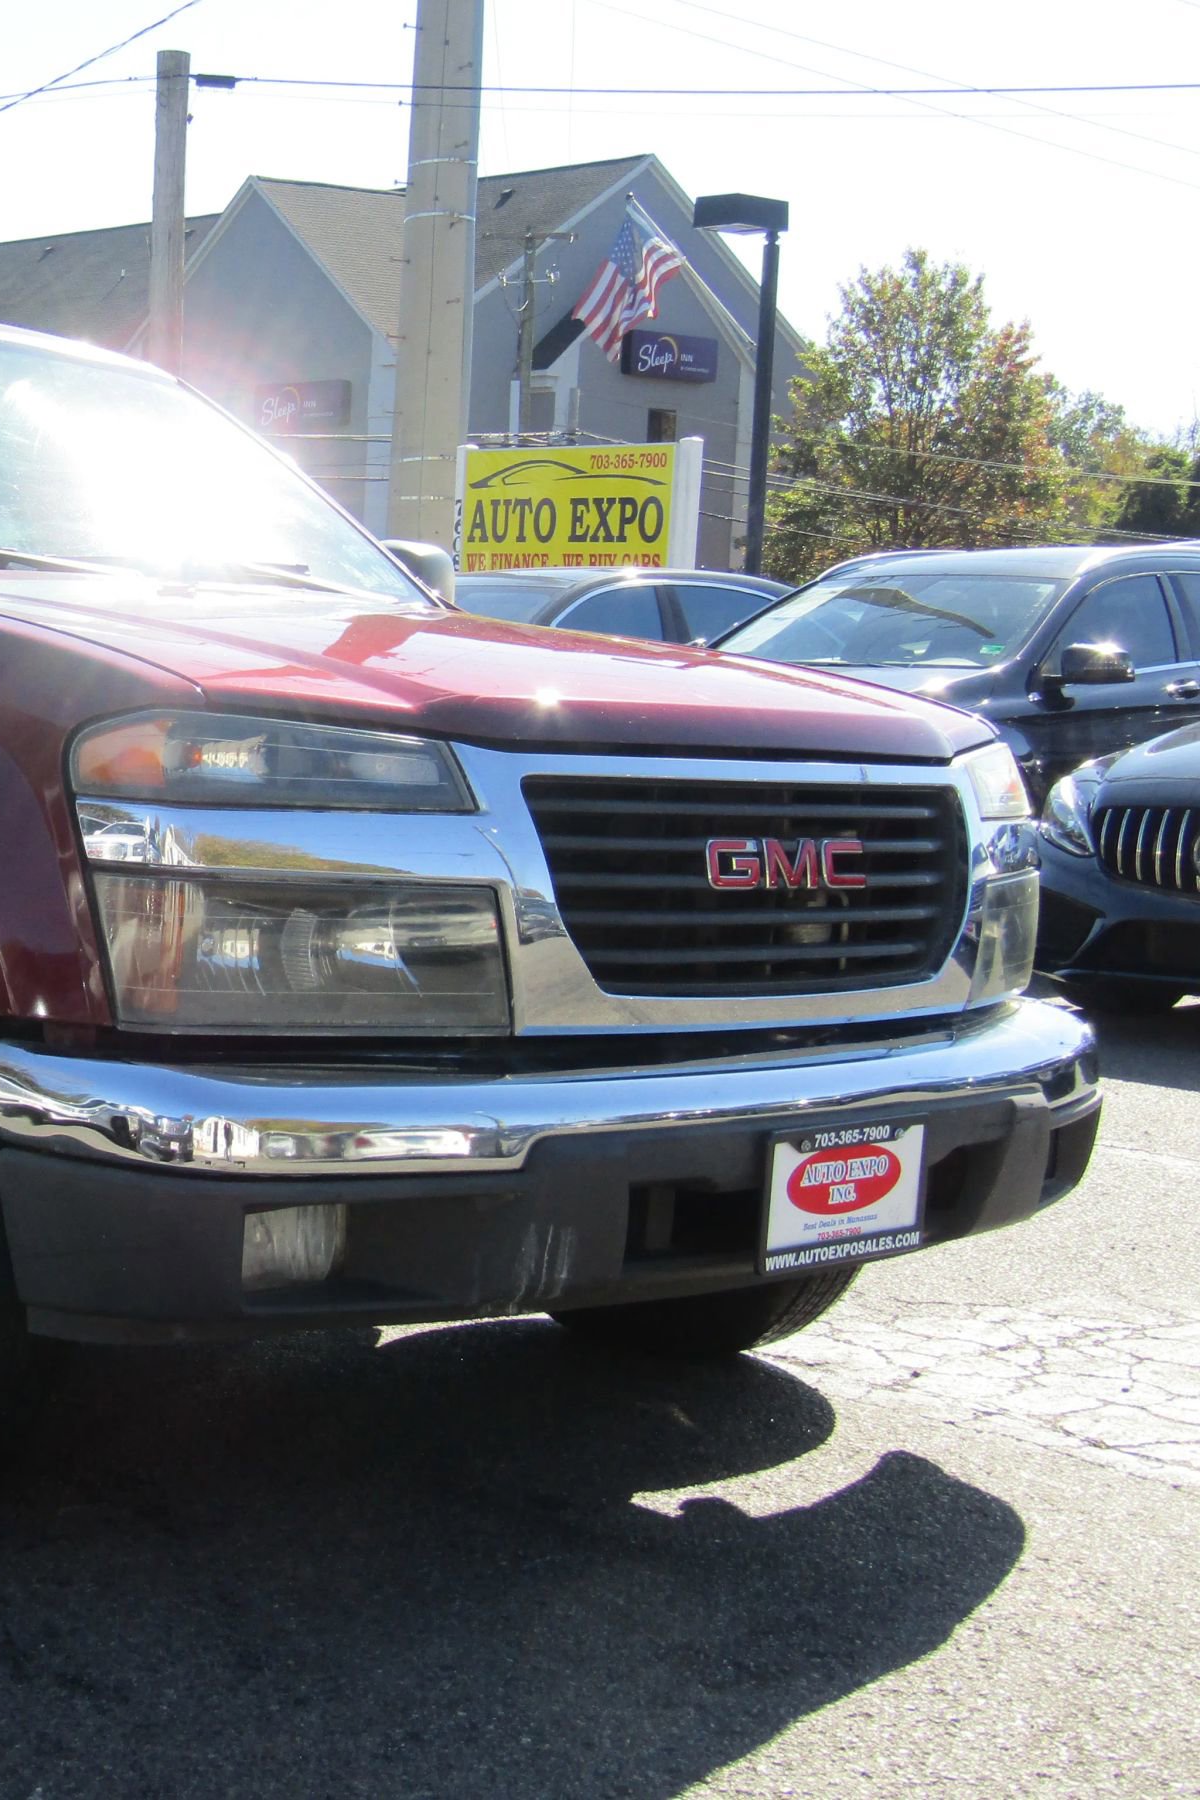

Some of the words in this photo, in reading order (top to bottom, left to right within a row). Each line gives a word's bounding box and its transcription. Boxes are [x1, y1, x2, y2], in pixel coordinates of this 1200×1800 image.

[637, 344, 673, 374] Sleep
[261, 396, 296, 426] Sleep
[590, 452, 668, 470] 703-365-7900
[466, 497, 557, 543] AUTO
[567, 495, 665, 544] EXPO
[466, 553, 486, 572] WE
[706, 837, 867, 890] GMC
[814, 1124, 891, 1148] 703-365-7900
[801, 1161, 846, 1187] AUTO
[846, 1154, 889, 1181] EXPO
[828, 1183, 857, 1205] INC.
[765, 1231, 921, 1271] WWW.AUTOEXPOSALES.COM
